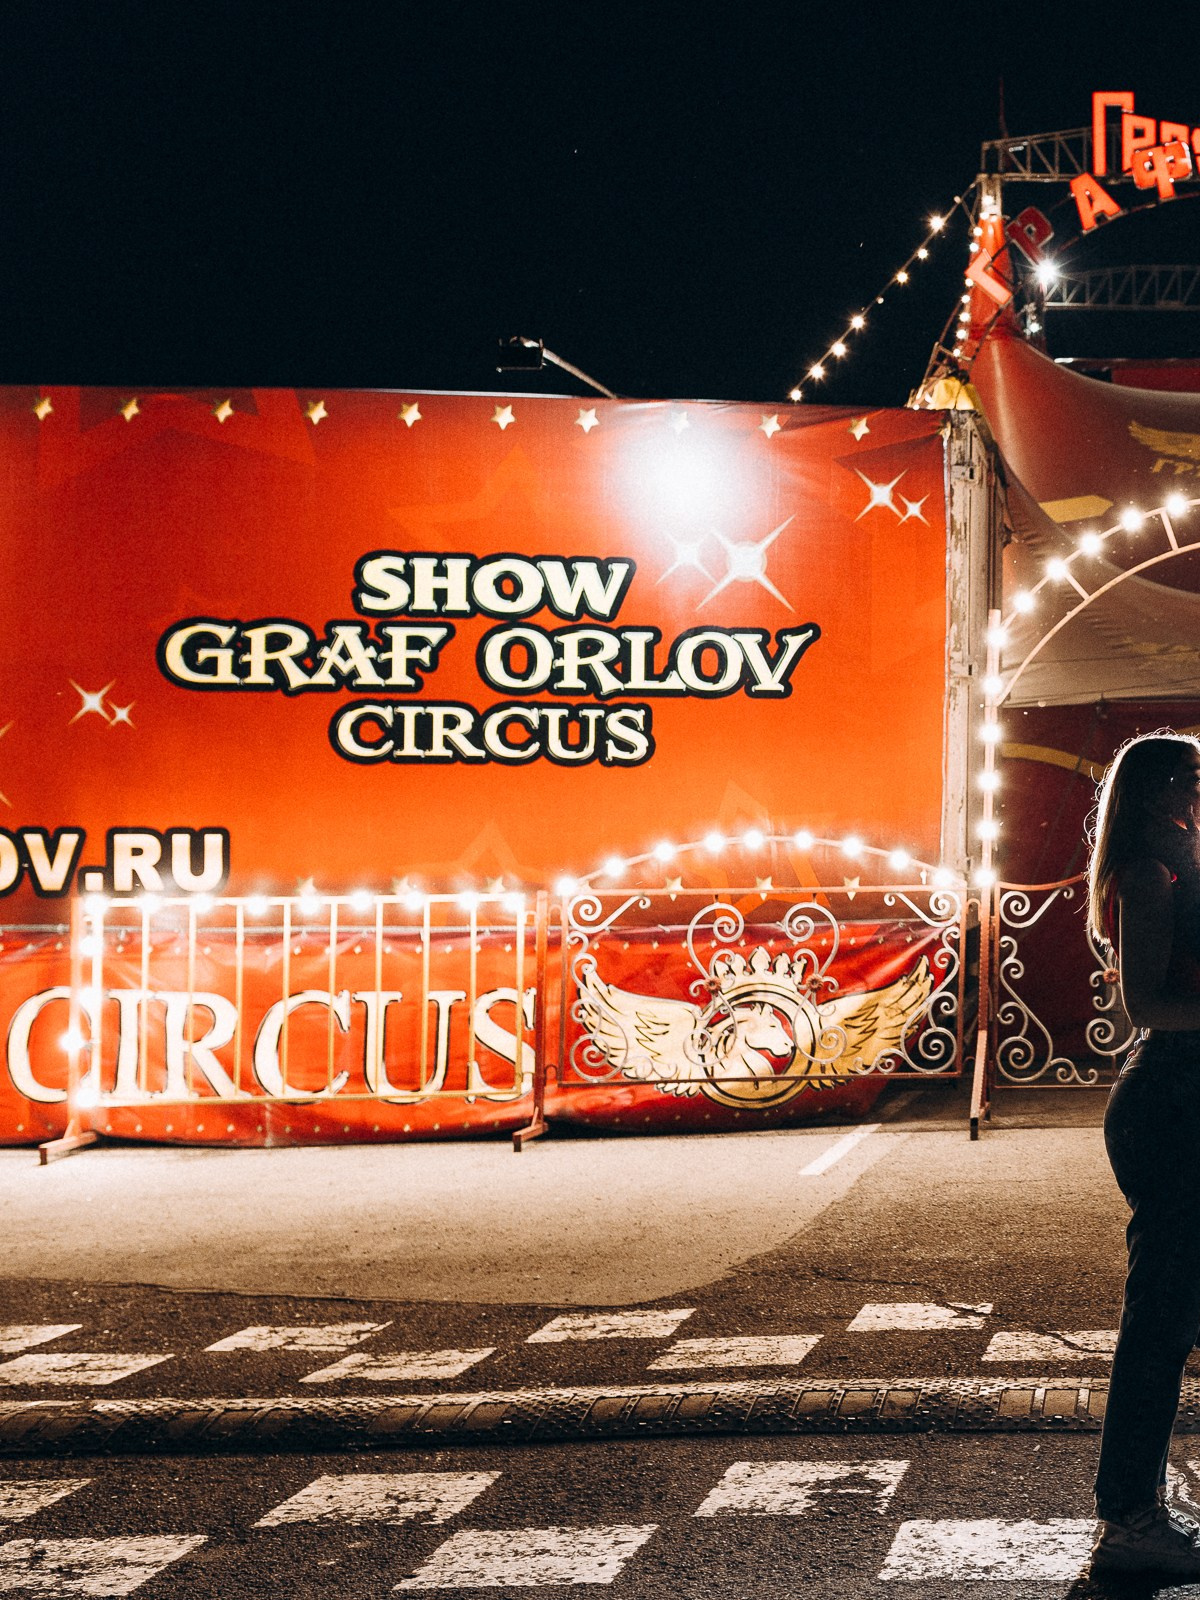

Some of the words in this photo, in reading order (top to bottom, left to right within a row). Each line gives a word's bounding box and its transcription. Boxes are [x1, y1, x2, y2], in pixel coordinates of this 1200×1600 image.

[965, 140, 1191, 306] ГРАФ
[360, 558, 631, 619] SHOW
[164, 624, 448, 691] GRAF
[481, 626, 815, 696] ORLOV
[336, 705, 651, 764] CIRCUS
[7, 985, 537, 1104] CIRCUS
